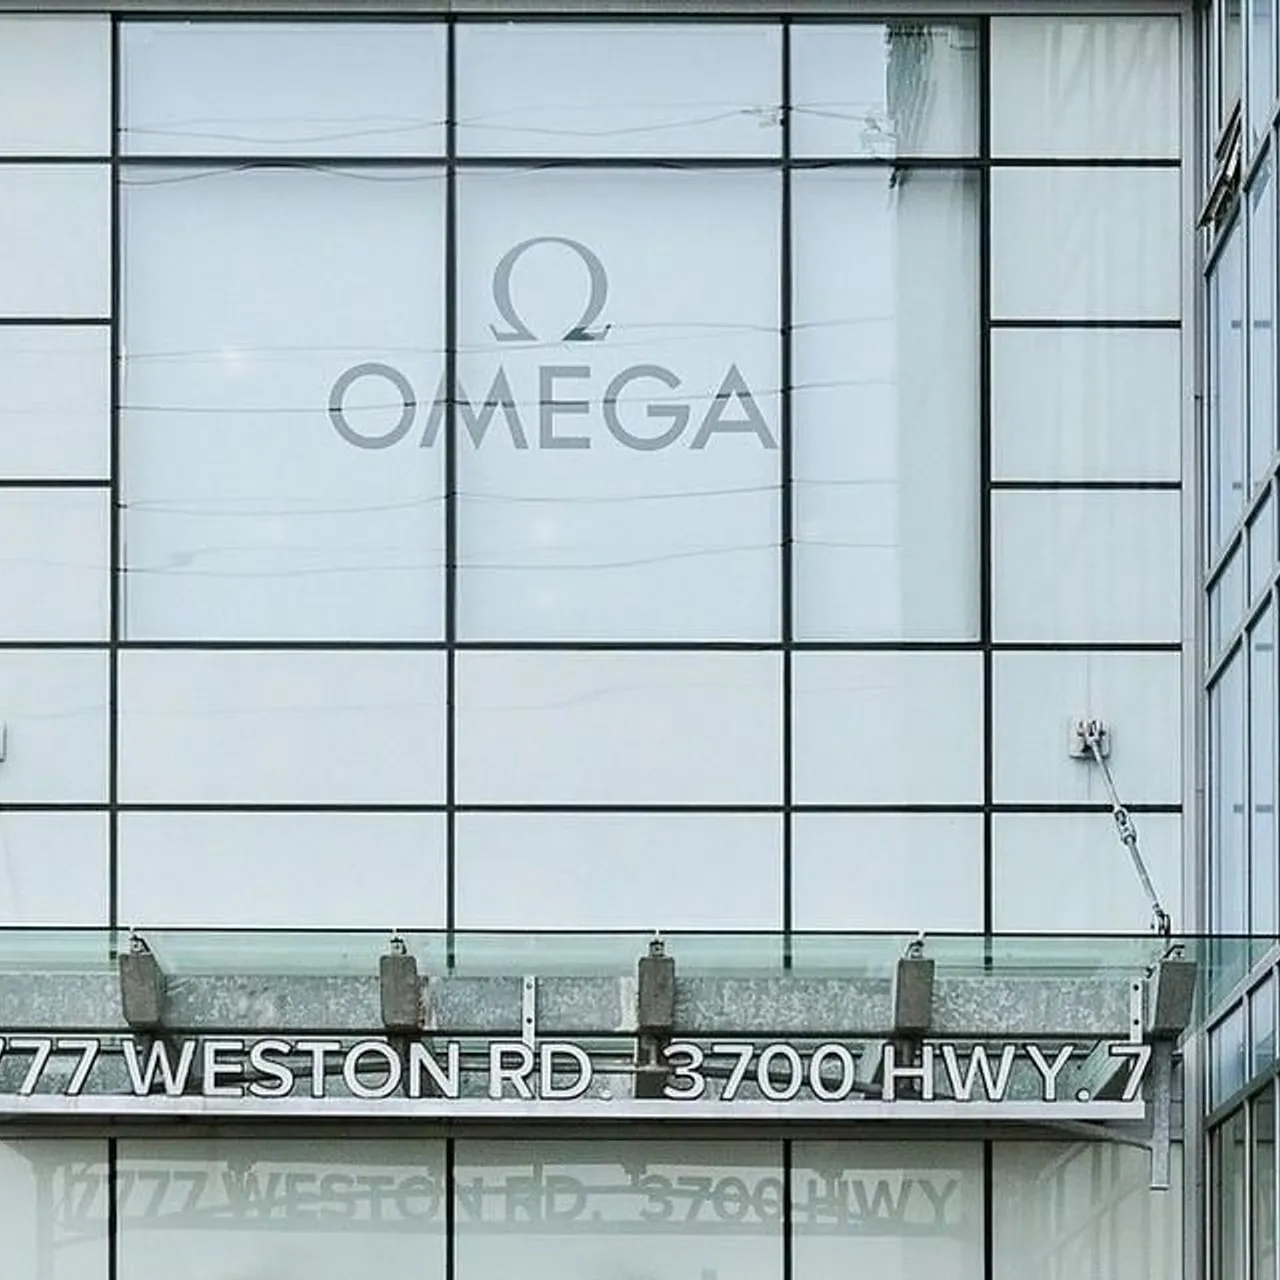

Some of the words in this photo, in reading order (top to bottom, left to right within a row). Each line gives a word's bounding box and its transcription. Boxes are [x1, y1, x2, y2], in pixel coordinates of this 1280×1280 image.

[328, 362, 779, 452] OMEGA
[123, 1038, 461, 1099] WESTON
[489, 1041, 612, 1101] RD.
[663, 1041, 856, 1102] 3700
[882, 1043, 1093, 1103] HWY.
[1108, 1044, 1153, 1103] 7
